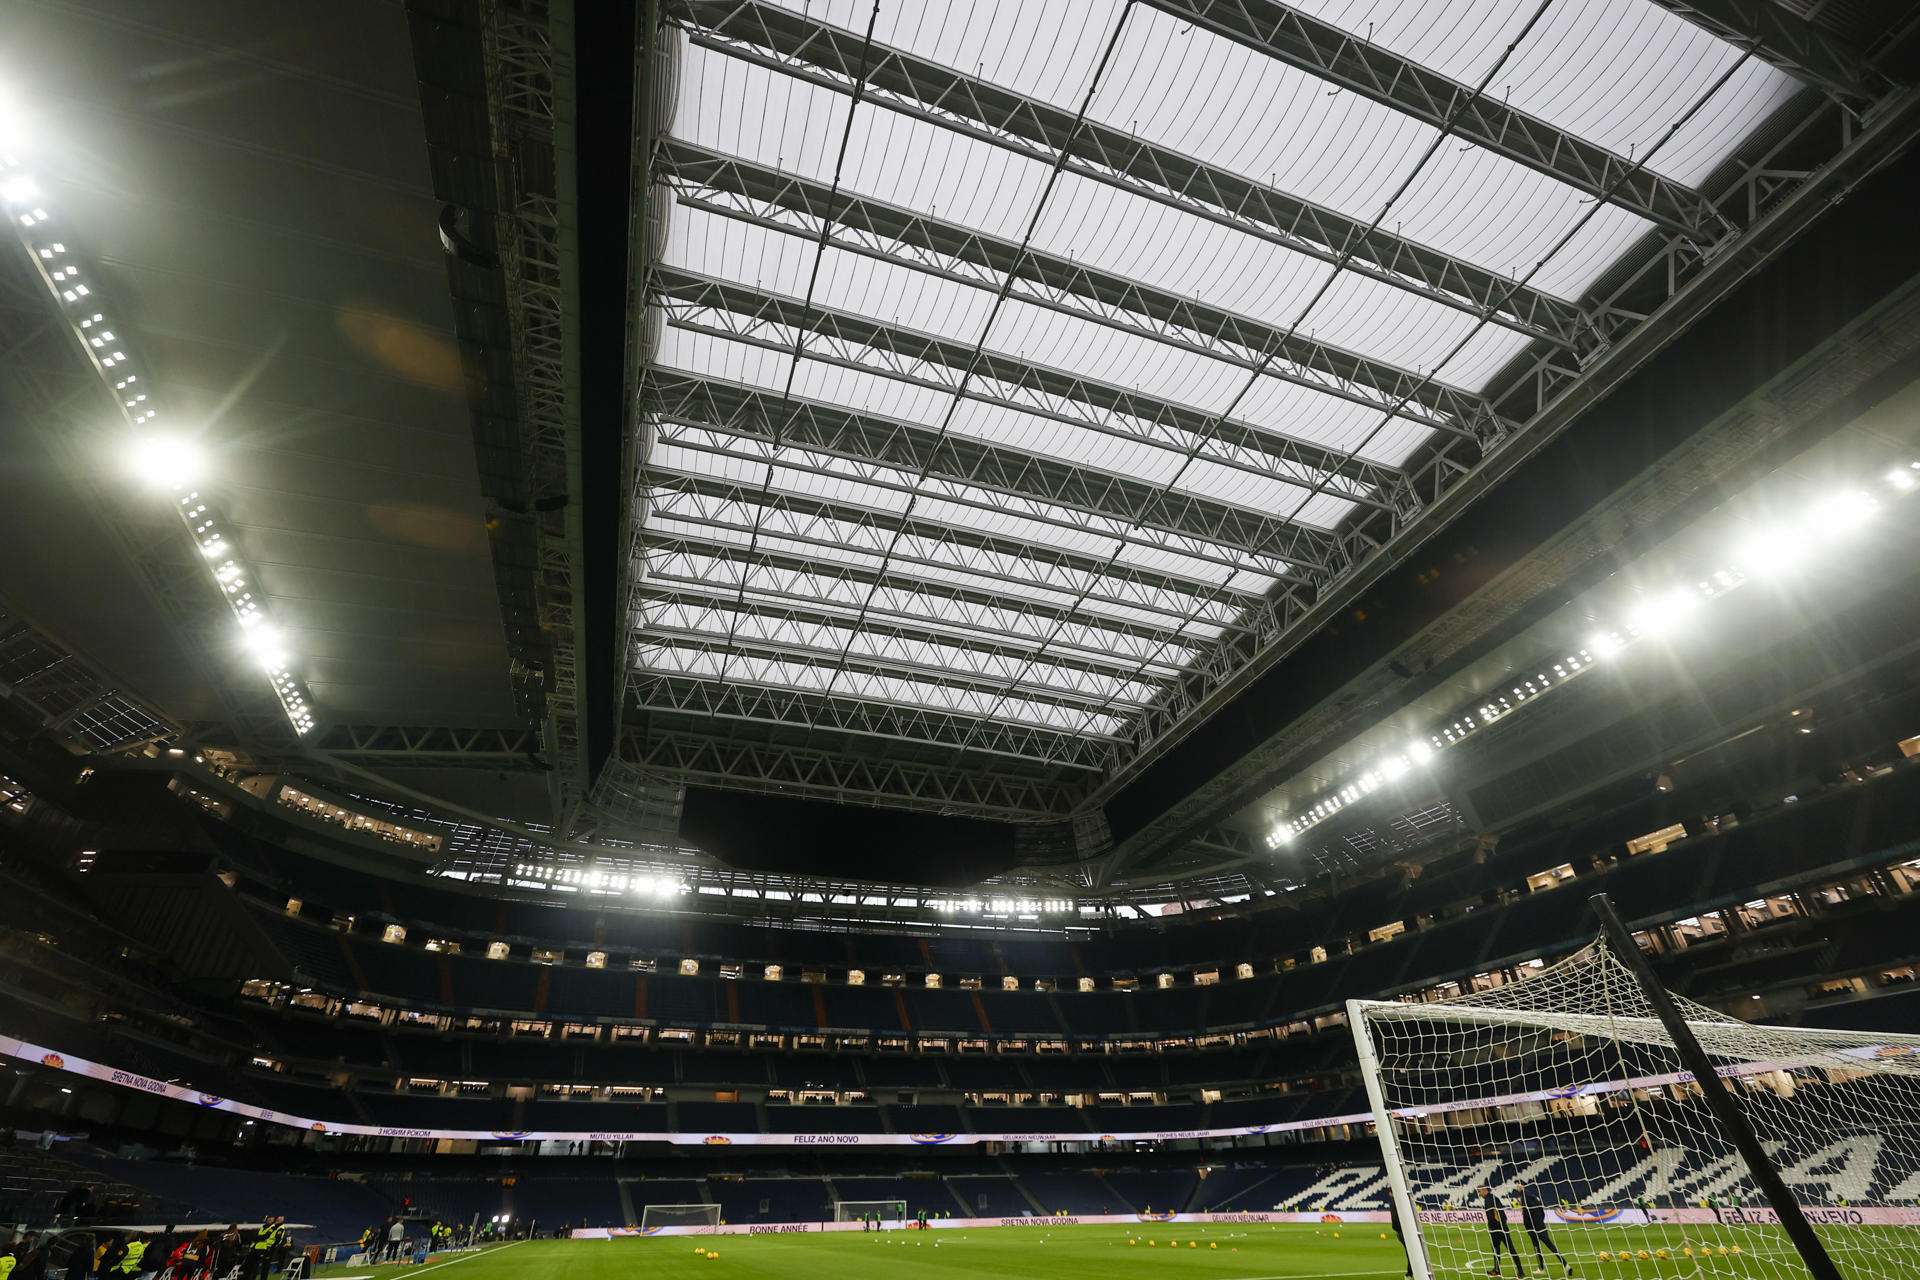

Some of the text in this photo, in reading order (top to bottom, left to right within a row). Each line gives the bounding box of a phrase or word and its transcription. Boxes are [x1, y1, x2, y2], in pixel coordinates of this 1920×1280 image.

[383, 1129, 406, 1137] НОВИМ
[794, 1135, 859, 1143] FELIZ ANO NOVO
[1001, 1217, 1079, 1227] SRETNA NOVA GODINA
[1461, 1211, 1485, 1223] JAHR
[1803, 1210, 1863, 1224] NUEVO
[749, 1222, 808, 1234] BONNE ANNÉE
